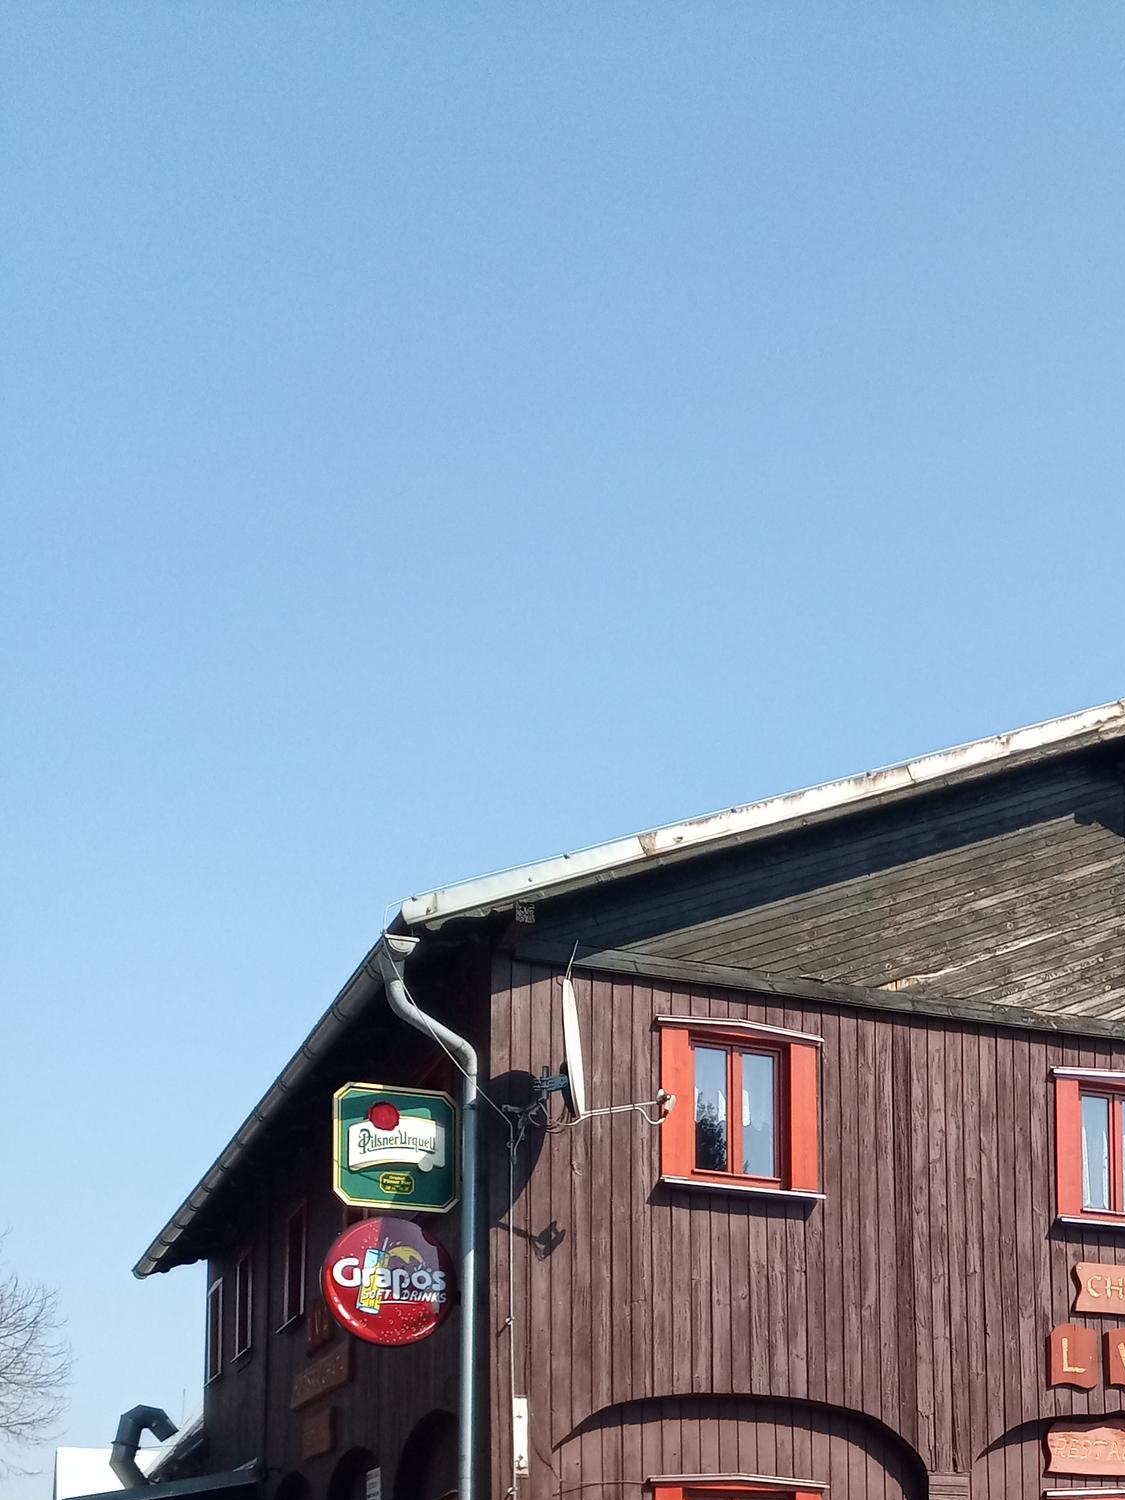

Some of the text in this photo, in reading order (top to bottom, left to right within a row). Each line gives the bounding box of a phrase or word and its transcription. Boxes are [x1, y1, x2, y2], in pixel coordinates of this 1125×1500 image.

[358, 1128, 438, 1154] Pilsner Urquell
[333, 1257, 446, 1299] Grapos
[361, 1289, 446, 1303] SOFT DRINKS
